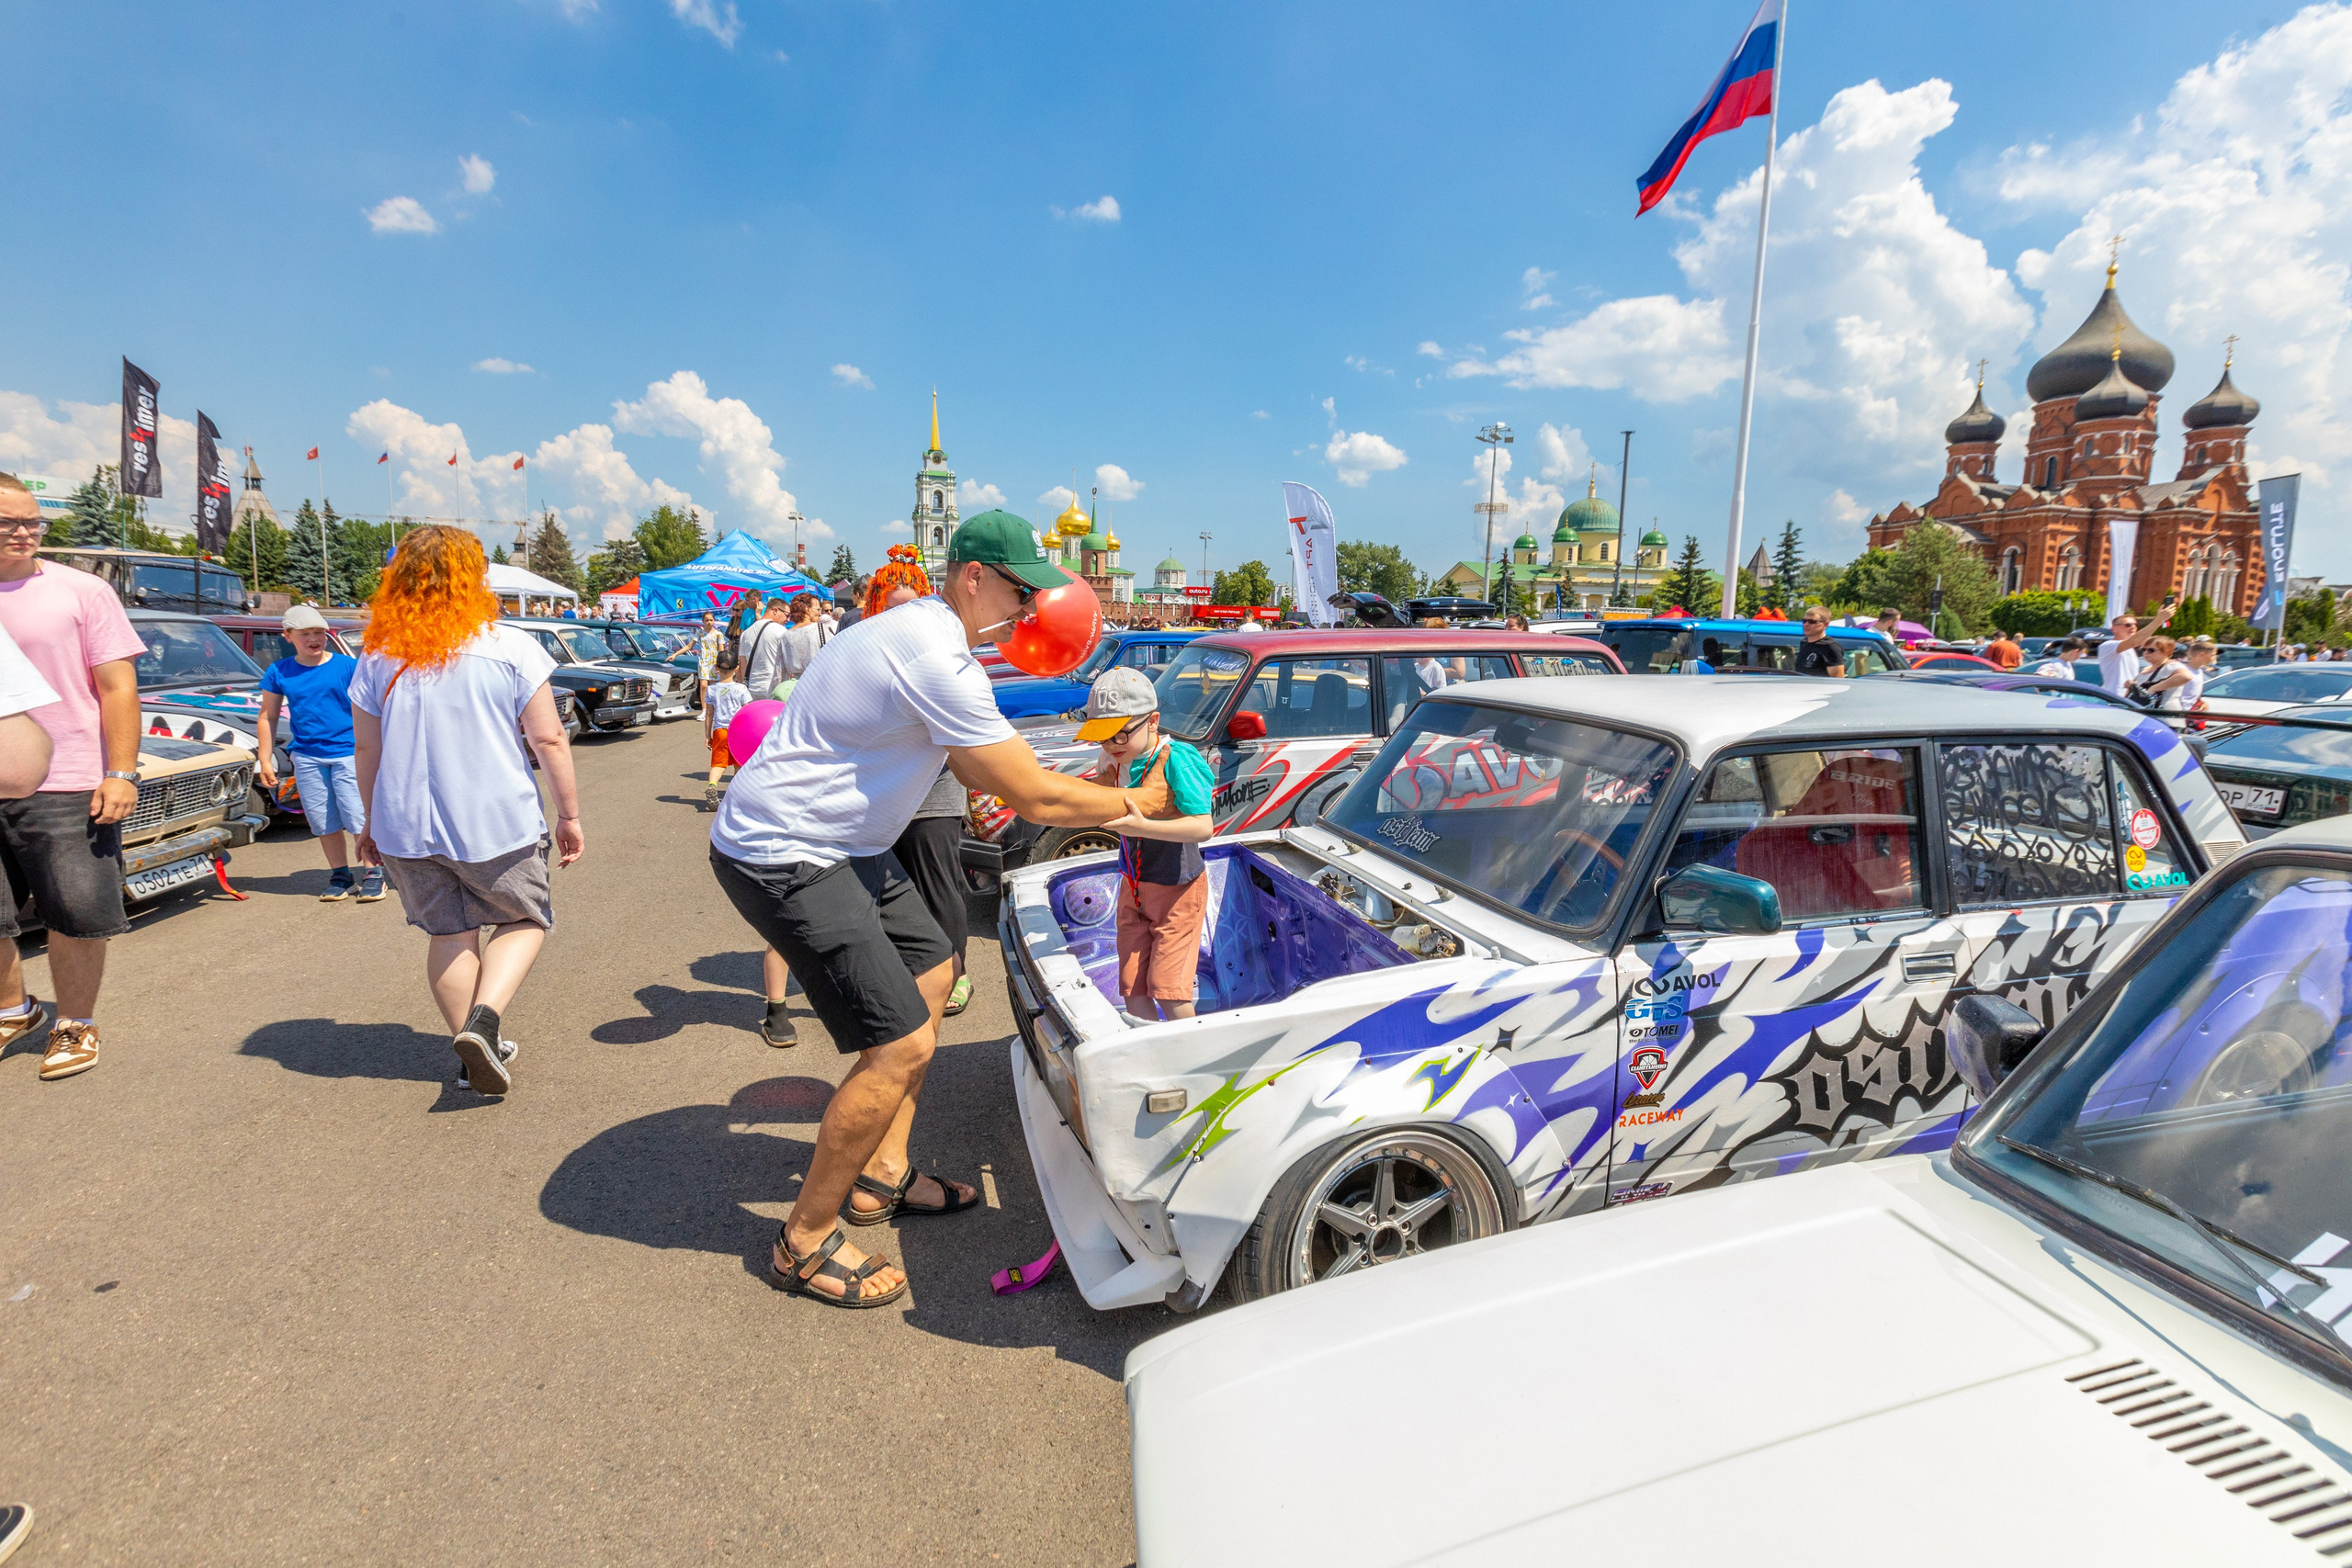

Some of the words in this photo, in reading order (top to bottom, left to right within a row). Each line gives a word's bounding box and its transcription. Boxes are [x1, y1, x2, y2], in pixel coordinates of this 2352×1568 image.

[129, 384, 155, 474] resttimer
[2269, 501, 2285, 583] EVOLUTE
[1830, 770, 1896, 790] BRIDE
[2253, 788, 2275, 805] 71
[189, 856, 208, 872] 71
[2154, 872, 2190, 887] AVOL
[1673, 973, 1721, 992] AVOL
[1624, 995, 1683, 1021] GTS
[1643, 1024, 1679, 1037] TOMEI
[1619, 1109, 1685, 1128] RACEWAY
